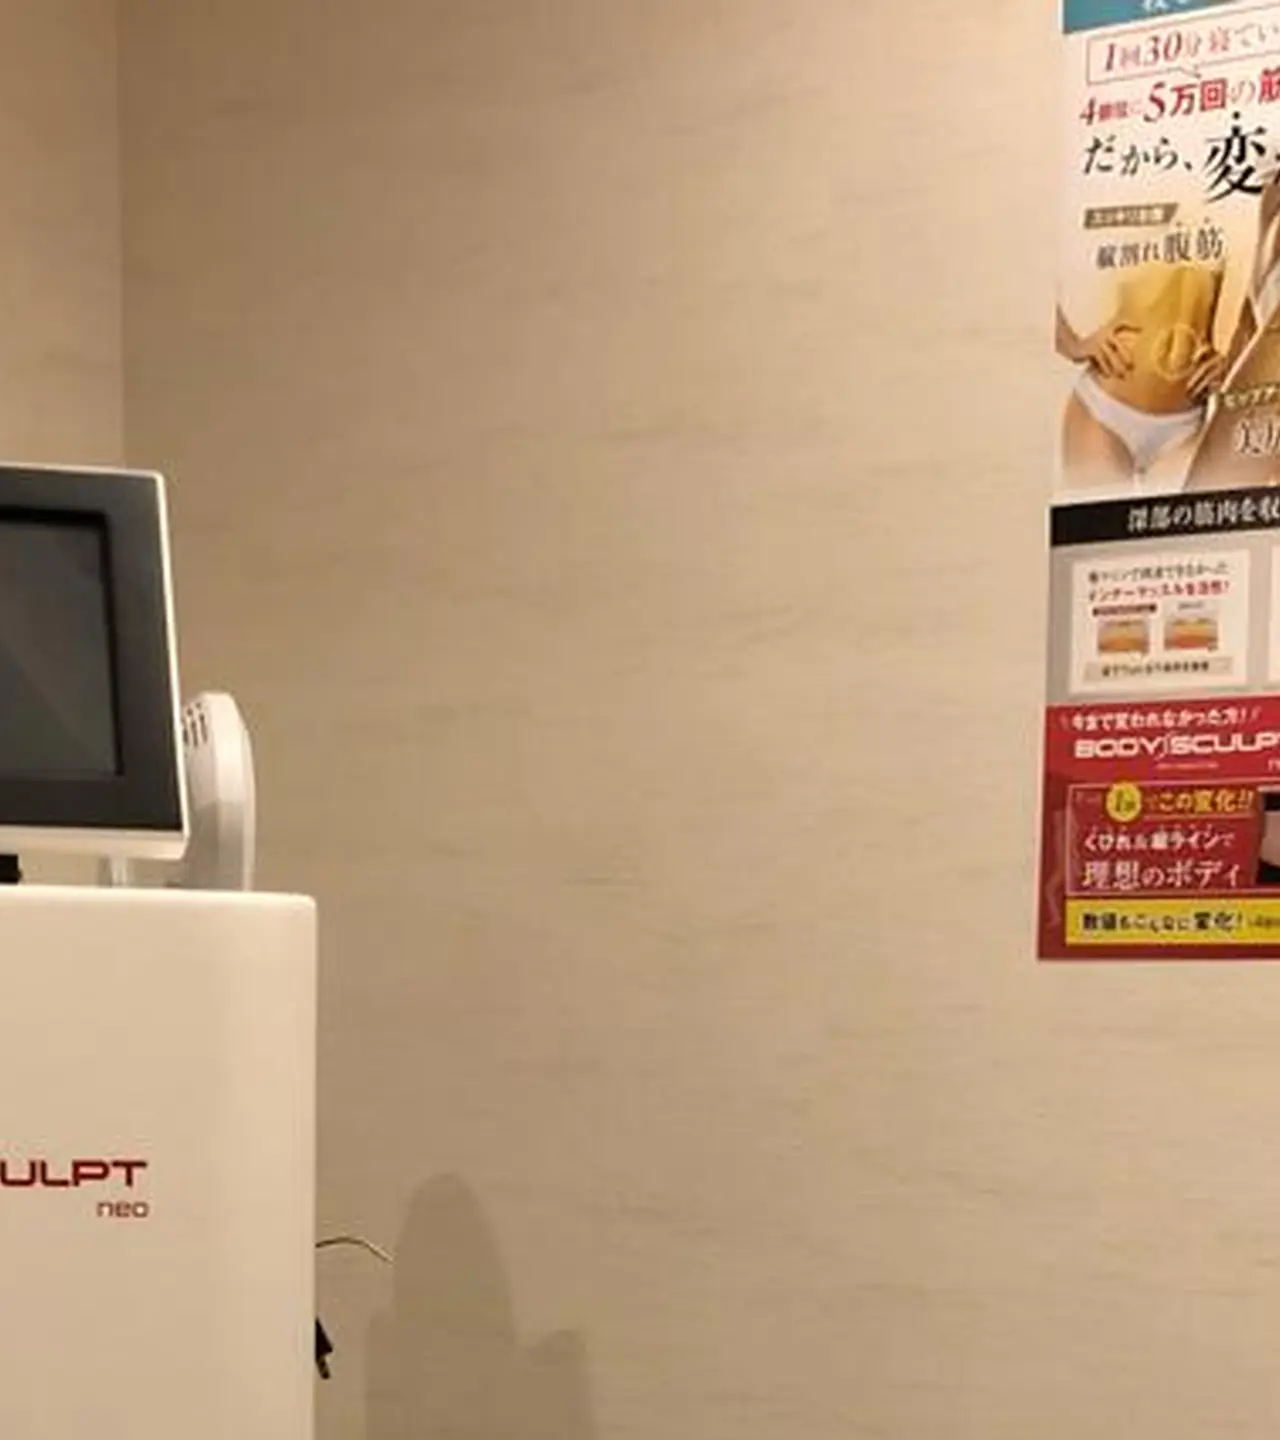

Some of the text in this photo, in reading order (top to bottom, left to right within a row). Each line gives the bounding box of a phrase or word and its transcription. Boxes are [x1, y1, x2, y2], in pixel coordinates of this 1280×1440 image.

[1082, 859, 1241, 891] 理想のボディ
[96, 1201, 150, 1218] neo
